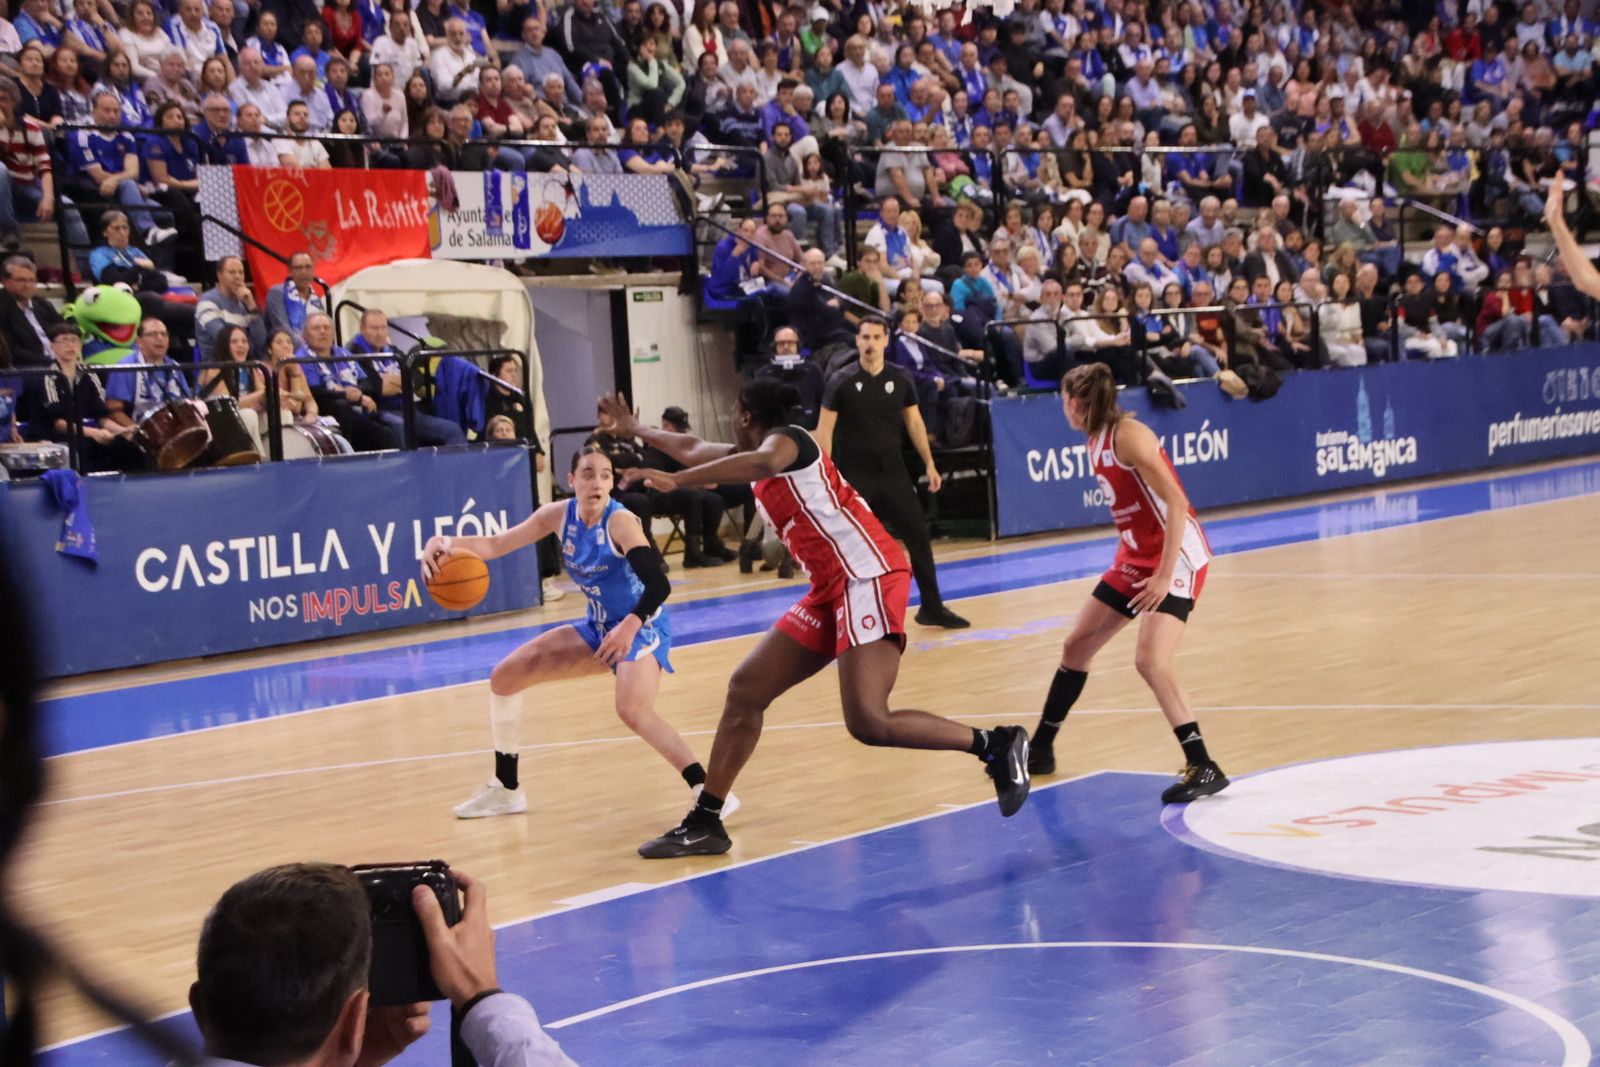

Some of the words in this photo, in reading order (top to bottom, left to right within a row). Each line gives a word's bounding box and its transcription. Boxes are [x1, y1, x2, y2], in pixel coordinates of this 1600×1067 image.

[448, 229, 464, 248] de
[467, 229, 513, 248] Salama
[1026, 444, 1095, 482] CASTI
[1172, 419, 1229, 466] LEÓN
[135, 528, 350, 593] CASTILLA
[367, 521, 396, 575] Y
[249, 594, 298, 623] NOS
[302, 578, 423, 626] IMPULSA
